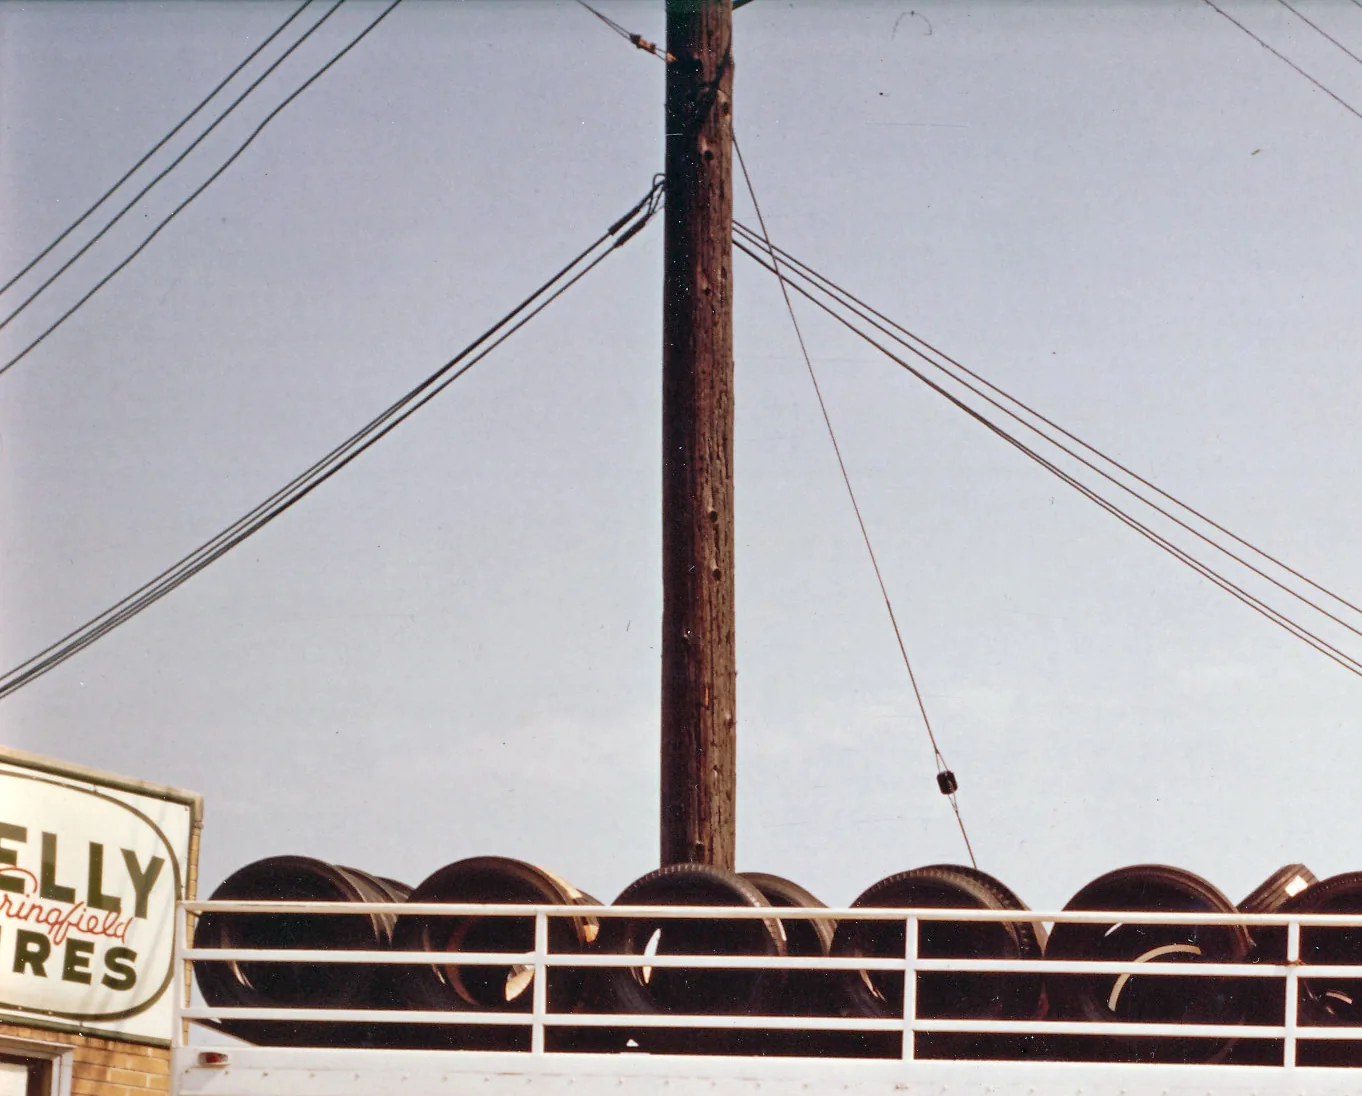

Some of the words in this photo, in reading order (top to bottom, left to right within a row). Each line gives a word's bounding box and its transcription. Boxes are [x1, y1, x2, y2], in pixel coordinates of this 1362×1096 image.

[0, 821, 165, 920] ELLY
[0, 892, 133, 945] ringfield
[12, 928, 137, 991] RES
